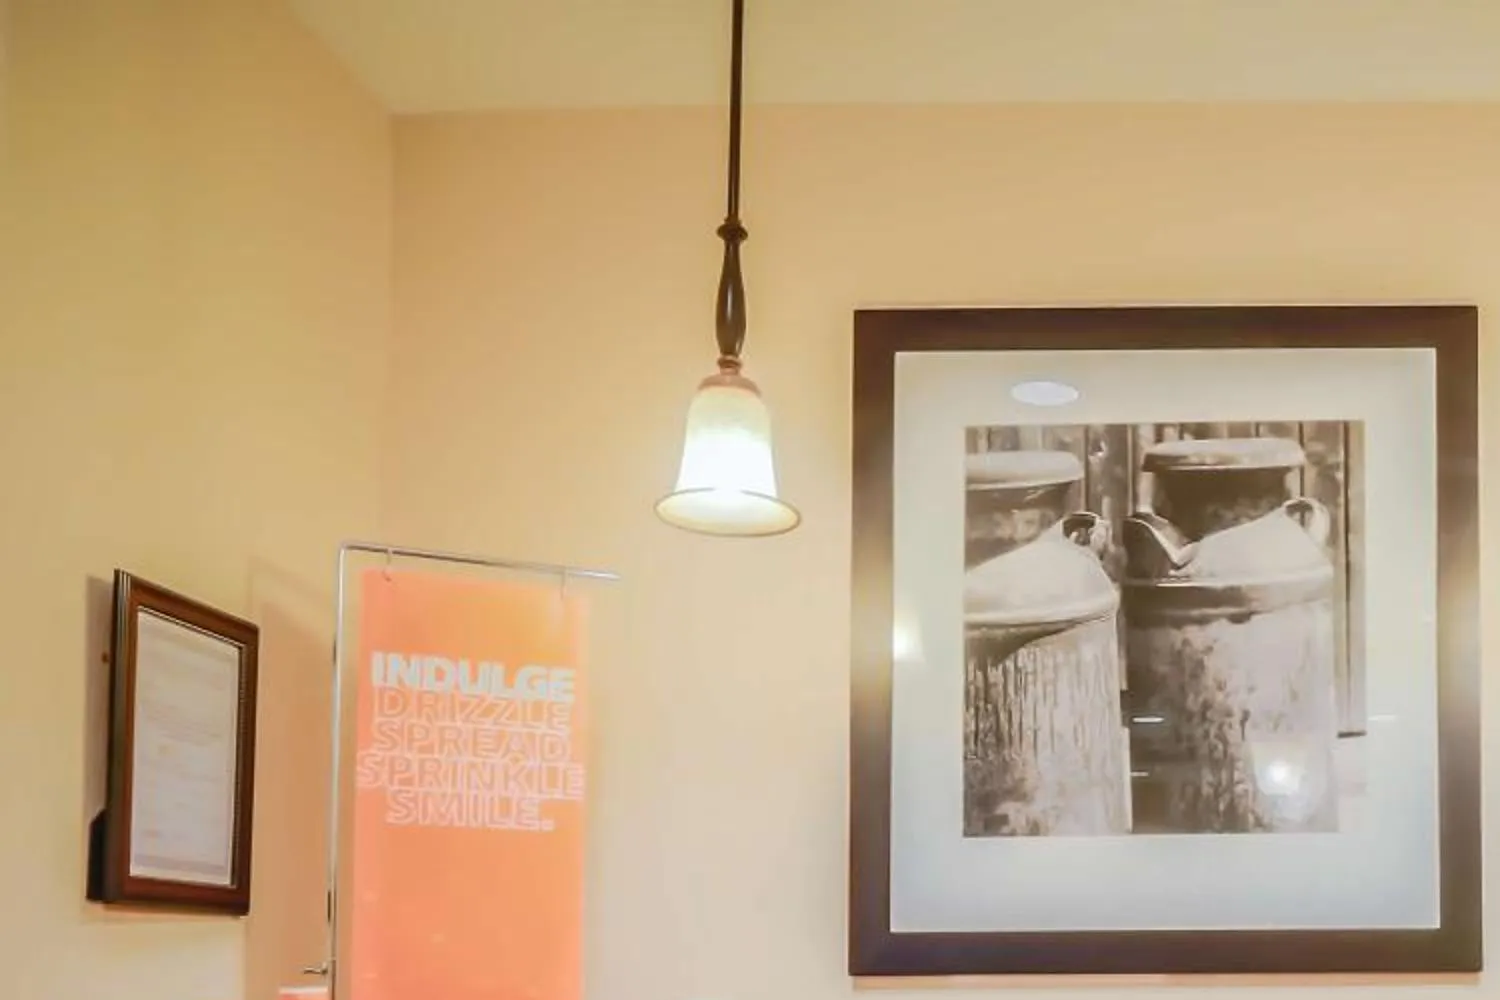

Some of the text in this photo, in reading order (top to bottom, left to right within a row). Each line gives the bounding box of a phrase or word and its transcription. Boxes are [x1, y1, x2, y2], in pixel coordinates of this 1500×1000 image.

[371, 650, 576, 701] INDULGE
[374, 686, 572, 731] DRIZZLE
[373, 719, 572, 762] SPREAD
[357, 750, 586, 801] SPRINKLE
[386, 789, 554, 831] SMILE.
